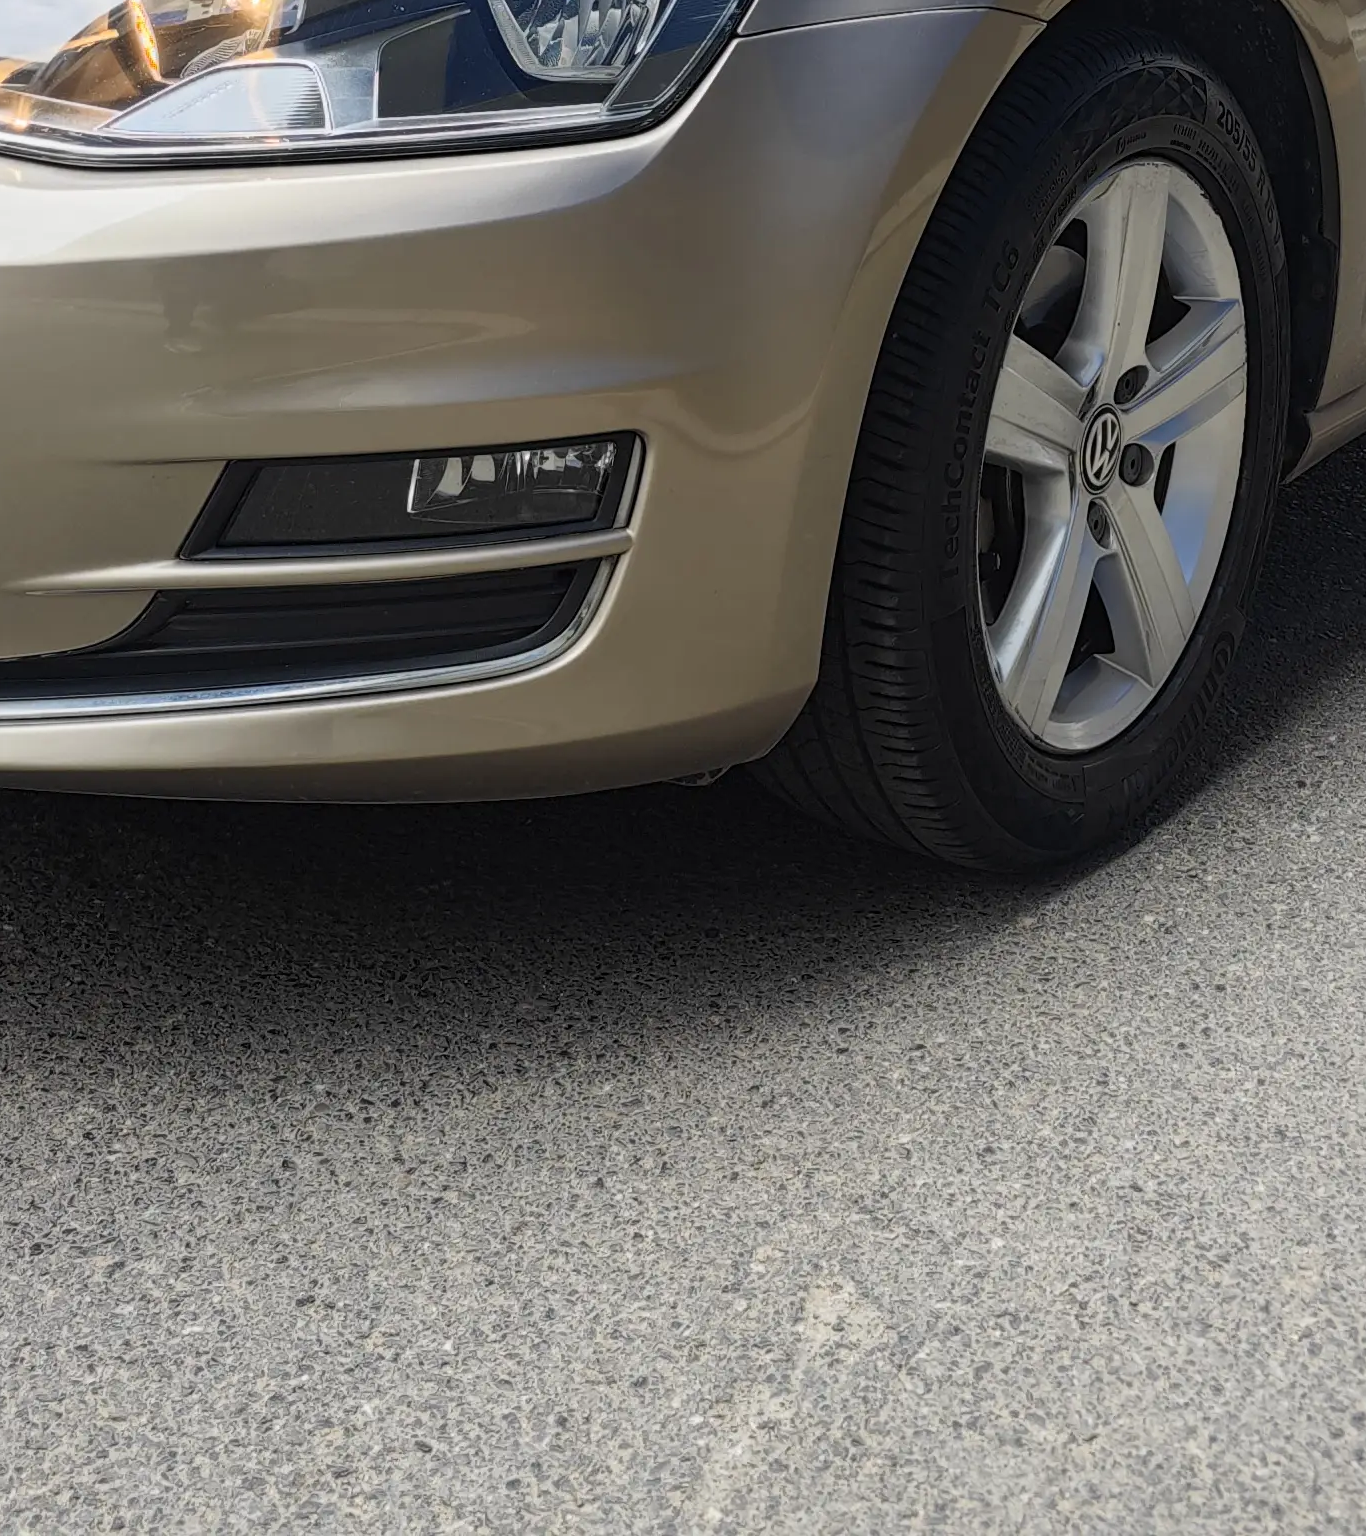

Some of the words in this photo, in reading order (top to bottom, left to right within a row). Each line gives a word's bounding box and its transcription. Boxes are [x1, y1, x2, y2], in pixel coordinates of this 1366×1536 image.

[1216, 99, 1257, 172] 205/55
[938, 327, 993, 585] TechContact
[980, 239, 1021, 315] TC6
